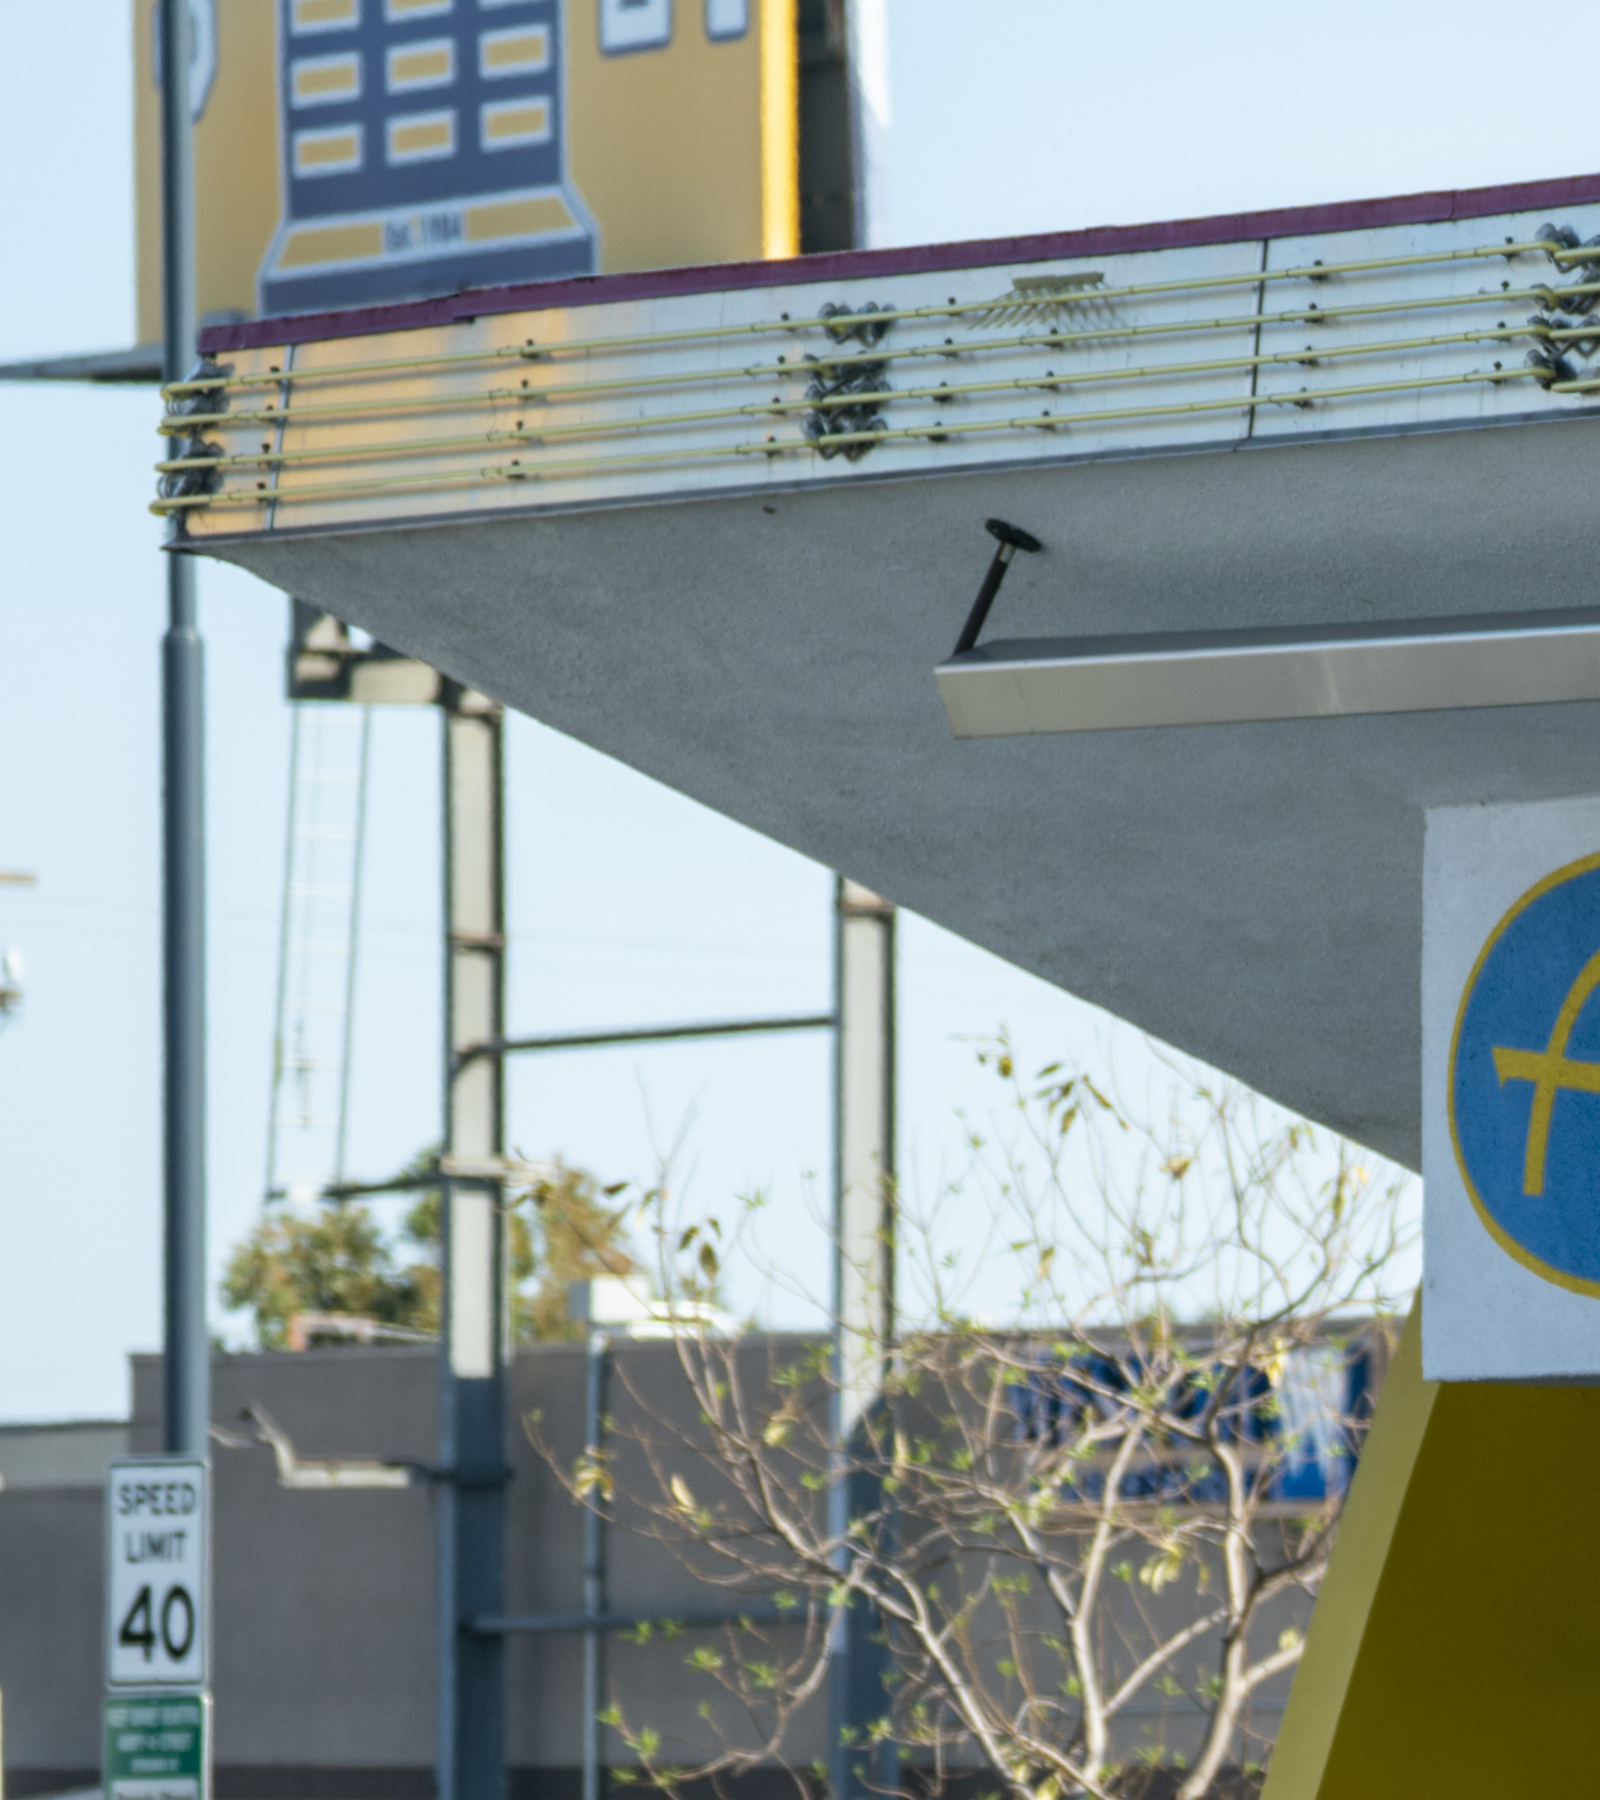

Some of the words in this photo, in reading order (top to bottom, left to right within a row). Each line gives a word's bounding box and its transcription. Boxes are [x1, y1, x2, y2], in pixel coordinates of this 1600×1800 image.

[117, 1482, 197, 1516] SPEED
[126, 1530, 188, 1563] LIMIT
[117, 1583, 197, 1662] 40
